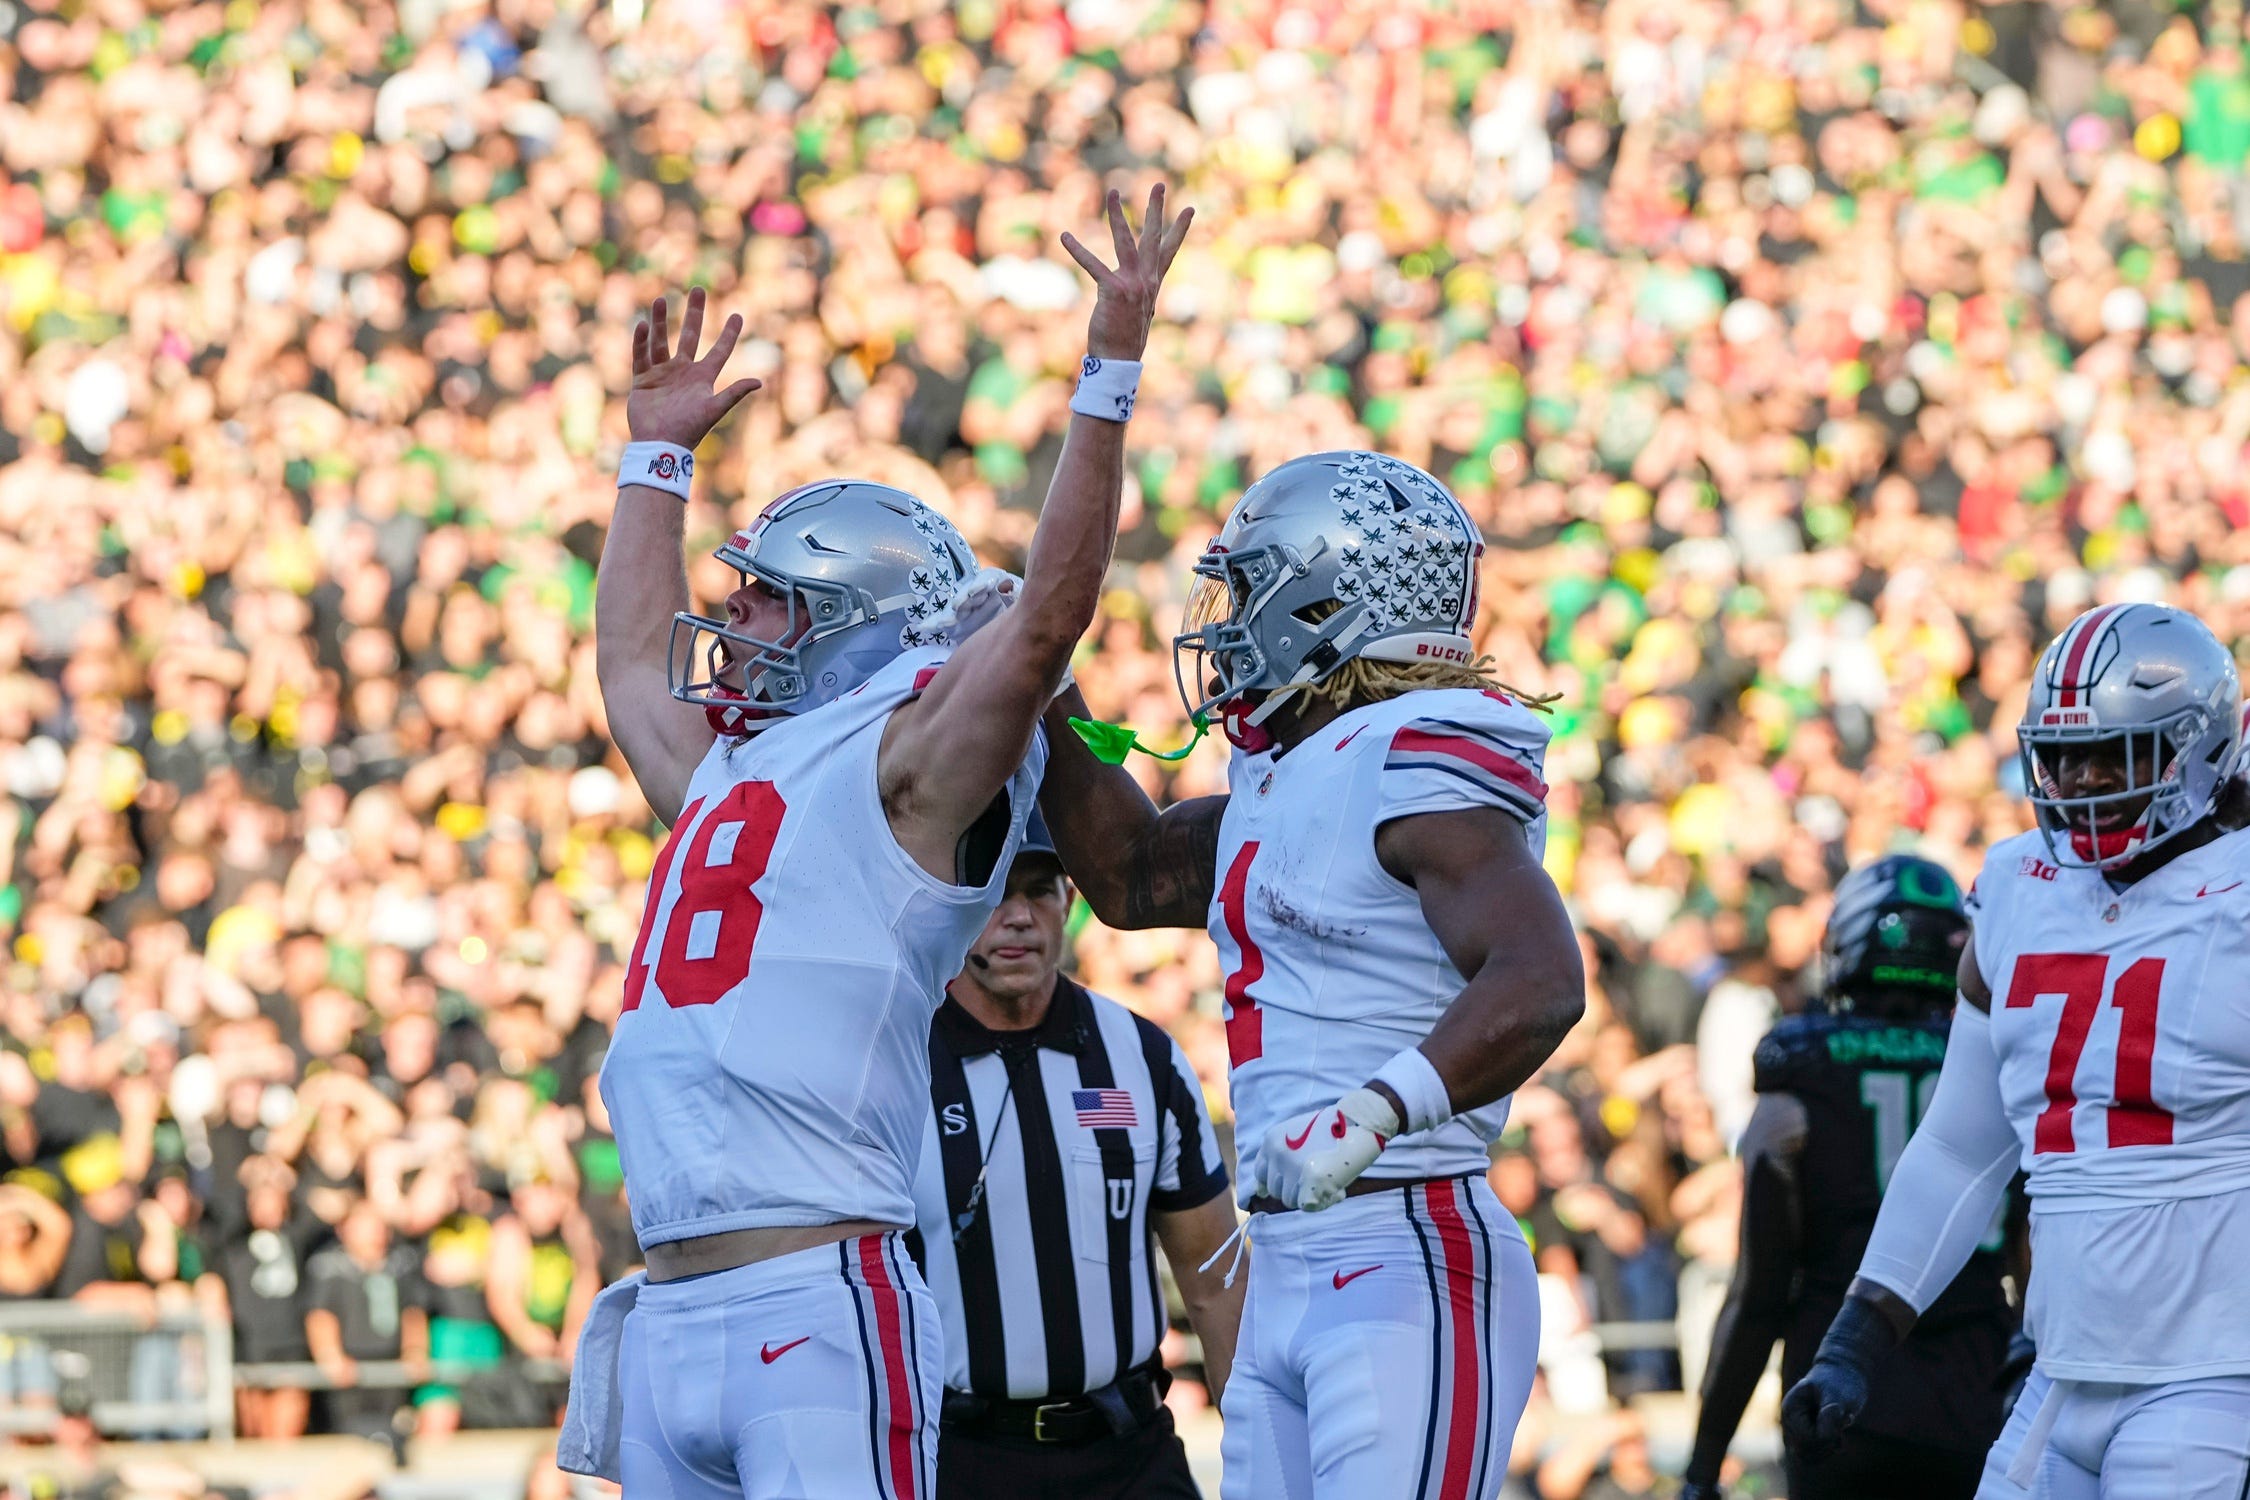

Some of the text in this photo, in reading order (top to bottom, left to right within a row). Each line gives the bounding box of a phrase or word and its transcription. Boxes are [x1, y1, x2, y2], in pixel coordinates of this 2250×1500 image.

[2064, 712, 2088, 724] STATE
[617, 780, 787, 1021] 18
[1217, 840, 1264, 1070] 1
[2005, 953, 2174, 1155] 71
[942, 1102, 969, 1136] S
[1107, 1178, 1133, 1220] U
